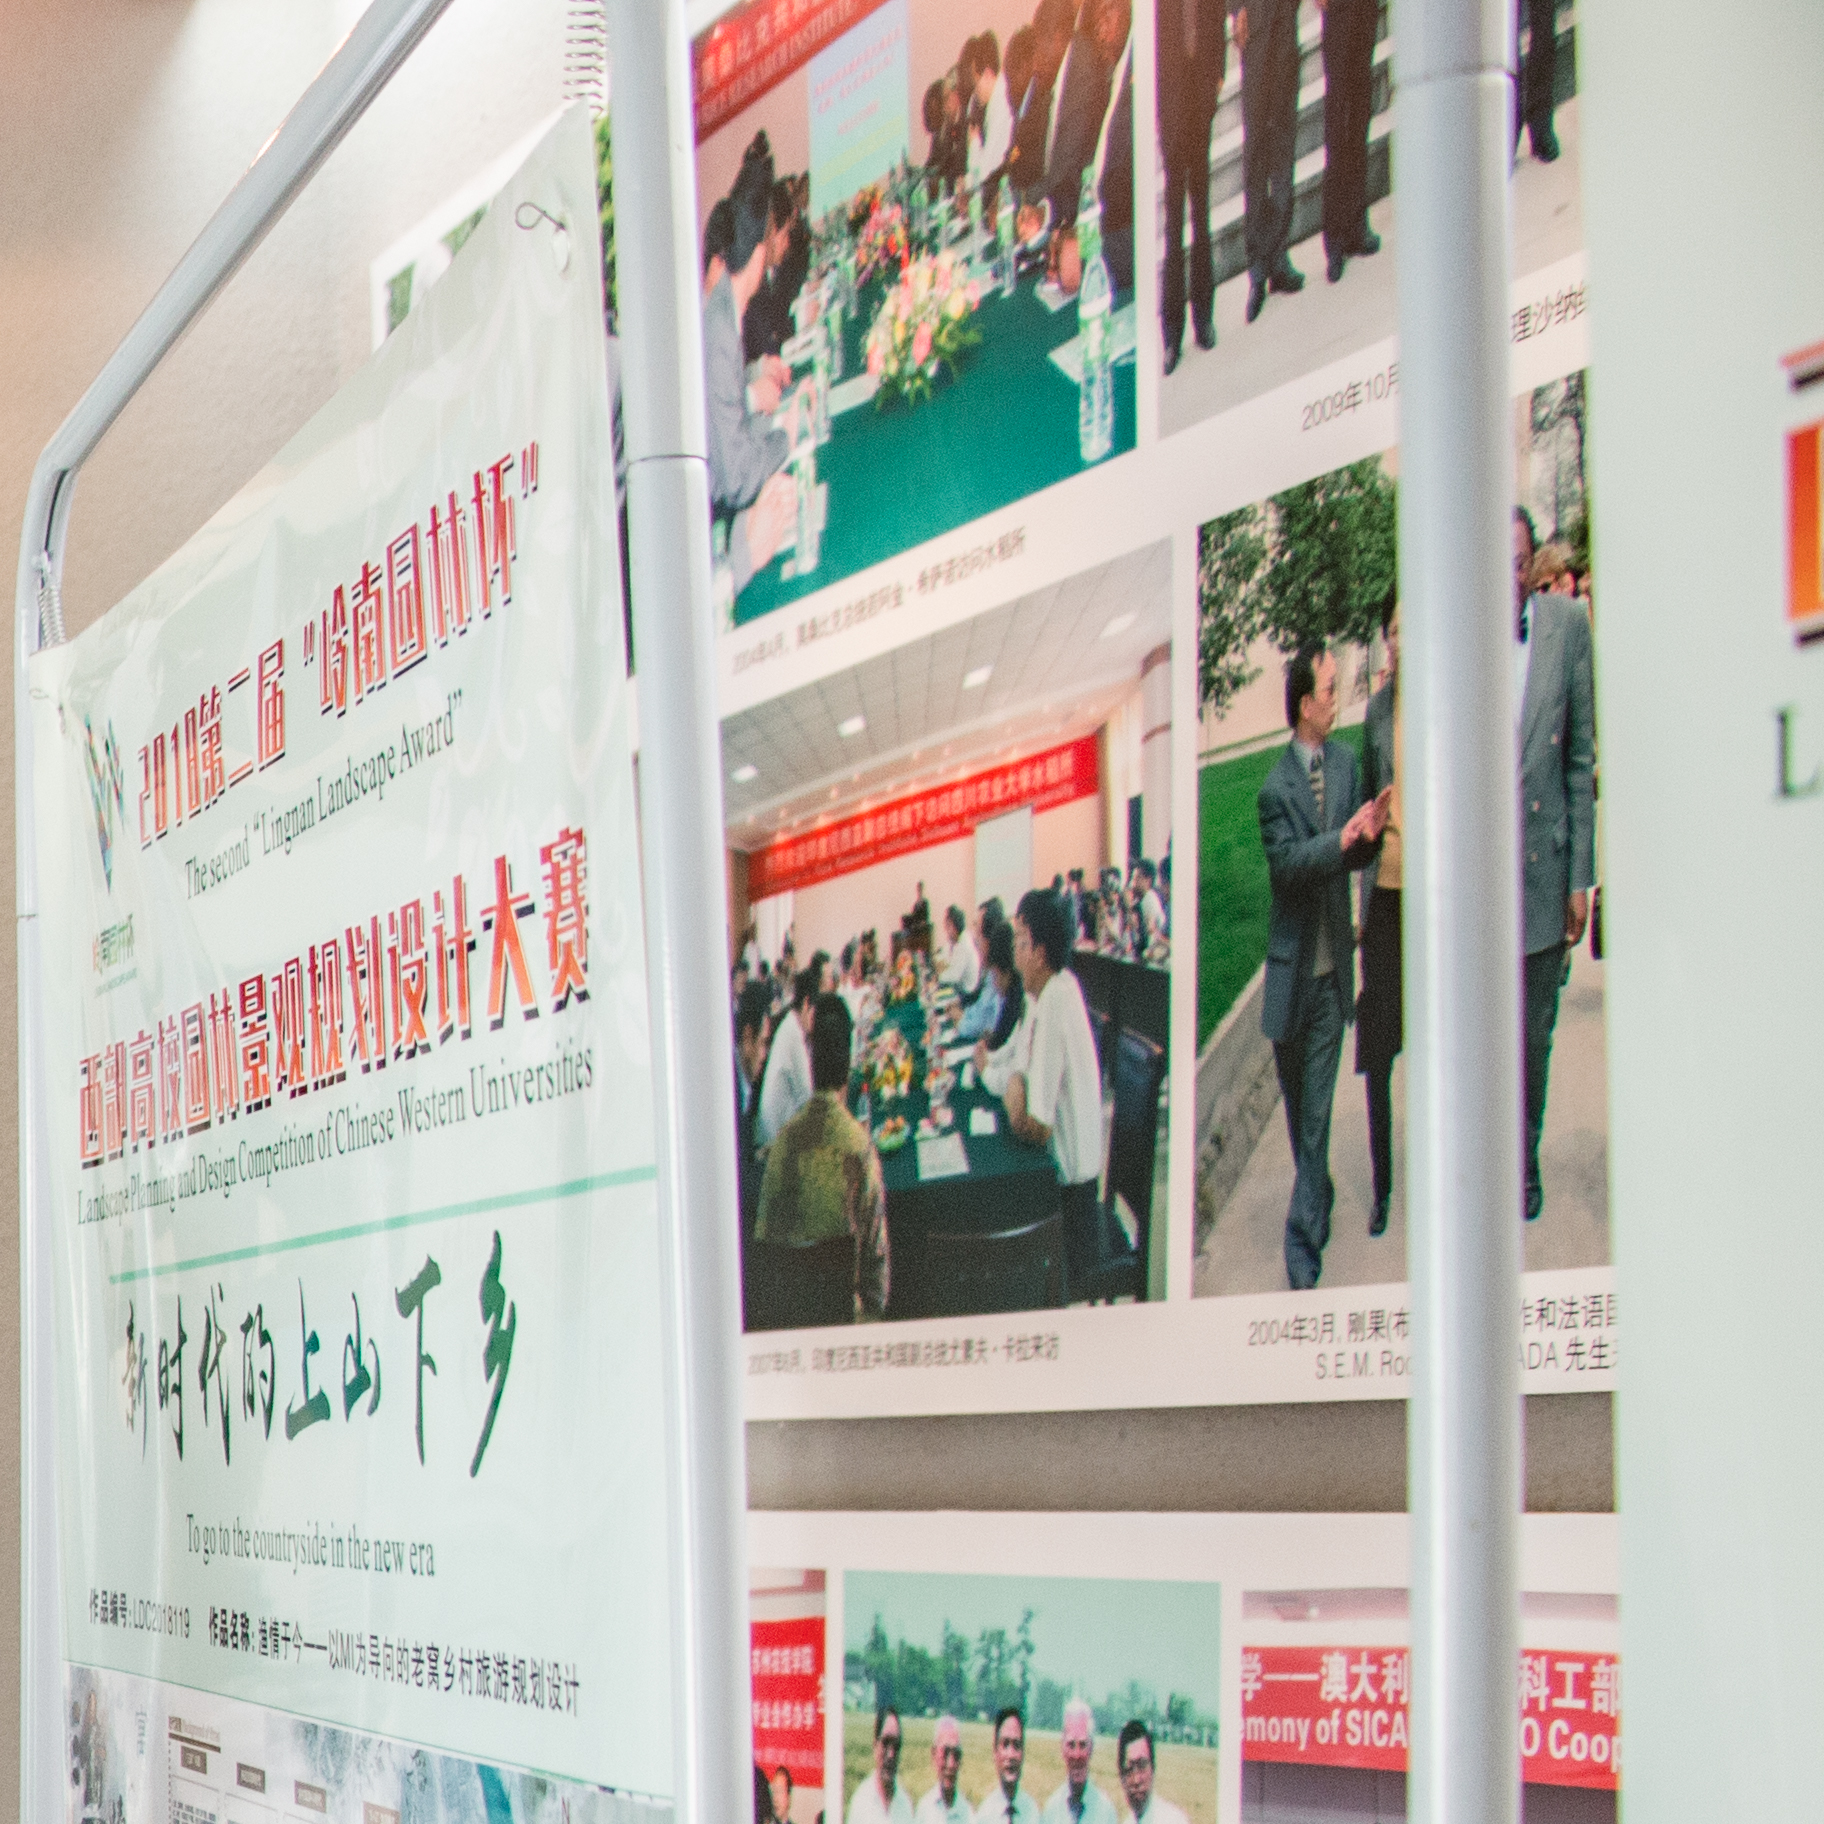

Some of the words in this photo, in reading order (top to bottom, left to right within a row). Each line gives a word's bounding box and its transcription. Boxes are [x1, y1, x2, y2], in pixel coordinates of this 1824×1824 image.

[184, 856, 207, 900] The
[210, 823, 251, 887] second
[317, 746, 396, 822] Landscape
[79, 825, 590, 1170] 西部高校园林景观规划设计大赛
[177, 1165, 197, 1200] and
[198, 1153, 237, 1199] Design
[238, 1120, 315, 1188] Competition
[317, 1110, 335, 1160] of
[335, 1102, 396, 1154] Chinese
[398, 1079, 466, 1139] Western
[468, 1036, 595, 1118] Universities
[121, 1228, 519, 1479] 新时代的上山下乡
[186, 1513, 201, 1554] To
[202, 1531, 217, 1566] go
[218, 1522, 231, 1557] to
[232, 1520, 252, 1560] the
[252, 1518, 329, 1576] countryside
[330, 1521, 346, 1569] in
[347, 1522, 371, 1572] the
[373, 1540, 407, 1575] new
[408, 1542, 437, 1578] era
[1316, 1708, 1341, 1746] of
